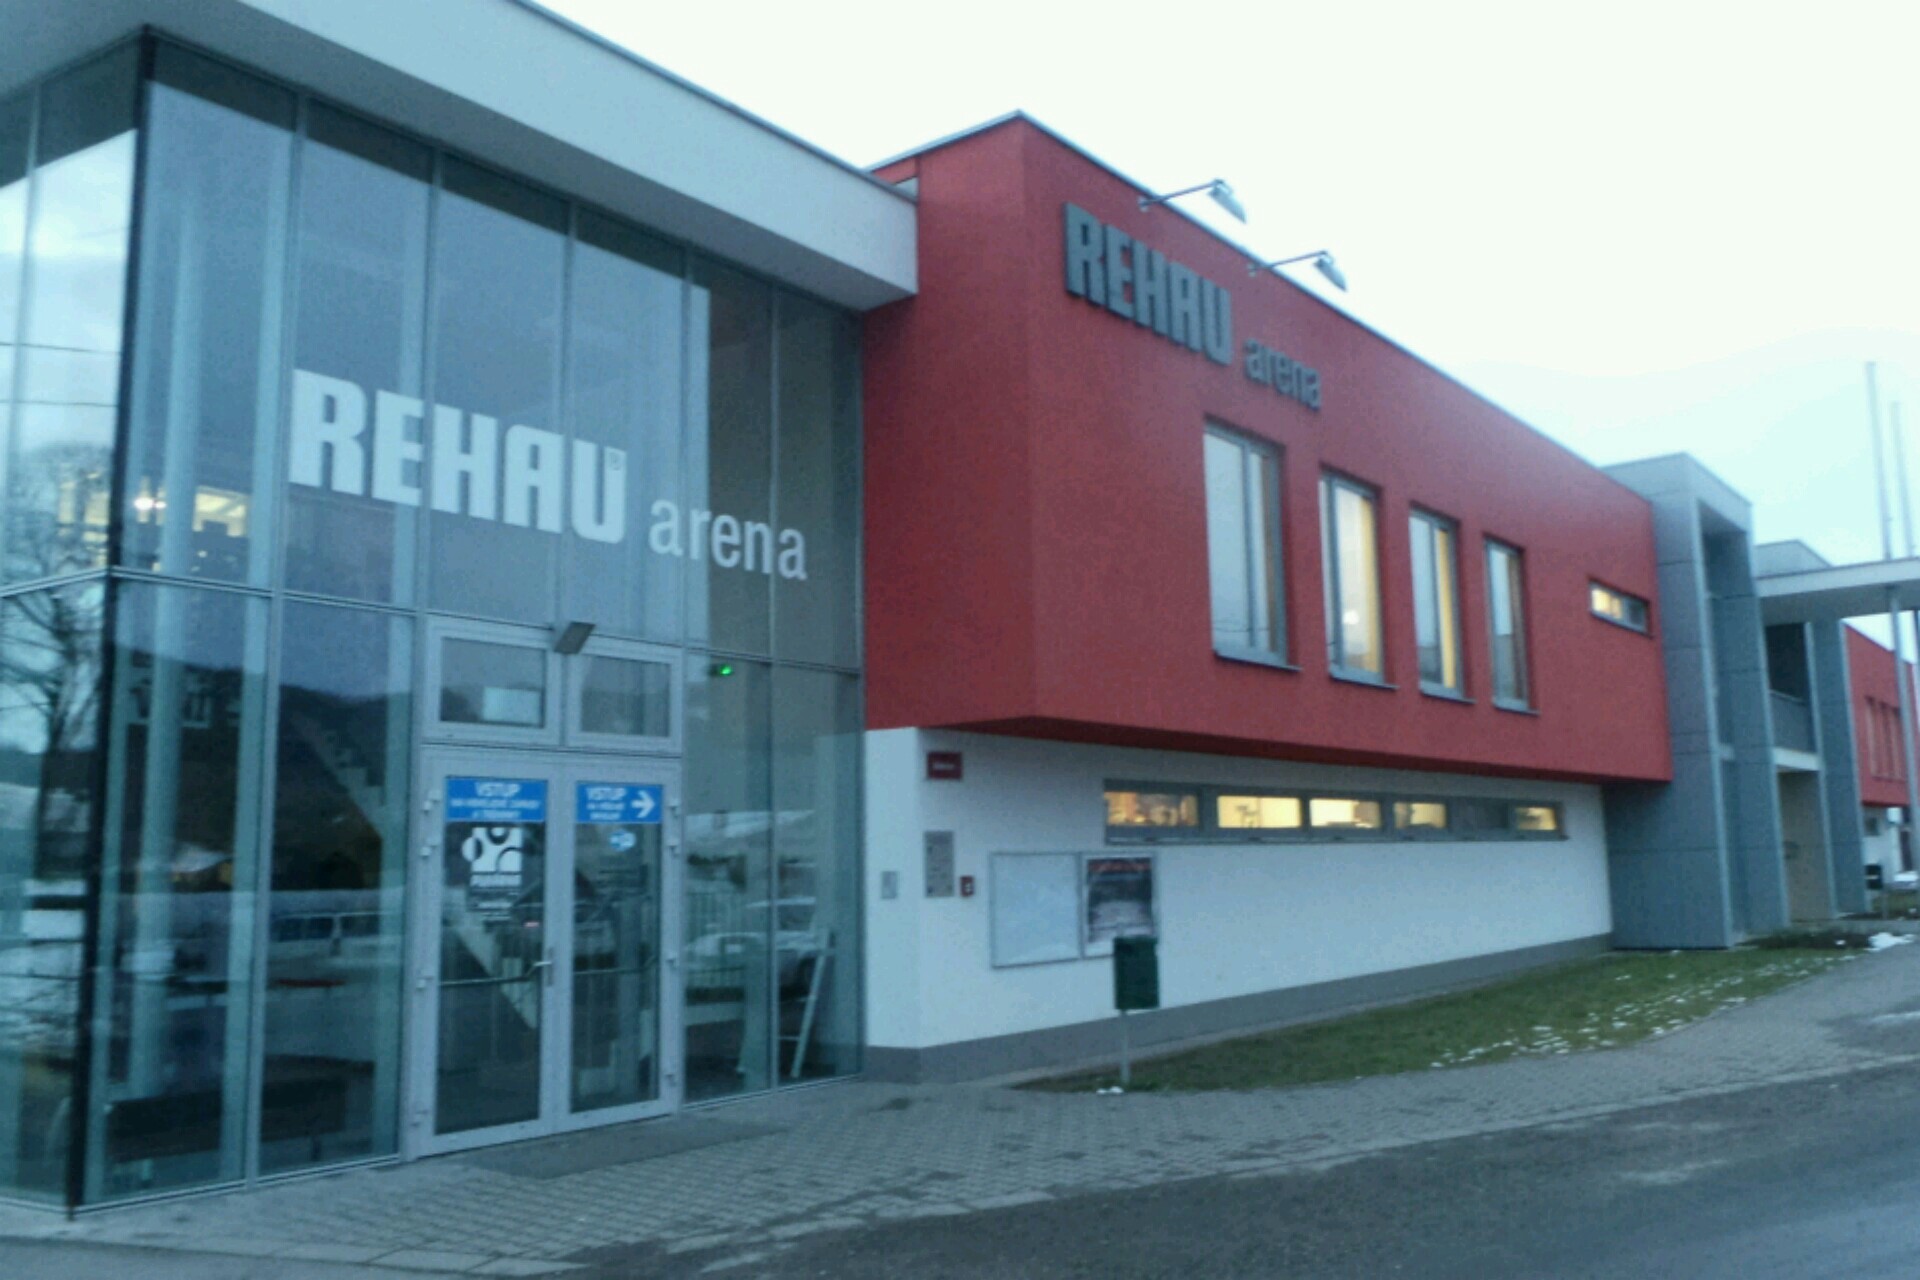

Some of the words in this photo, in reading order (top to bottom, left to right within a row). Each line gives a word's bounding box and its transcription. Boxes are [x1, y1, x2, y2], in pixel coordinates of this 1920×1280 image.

[1065, 200, 1232, 367] REHAU
[1245, 337, 1321, 411] arena
[288, 368, 626, 544] REHAU
[649, 499, 807, 580] arena
